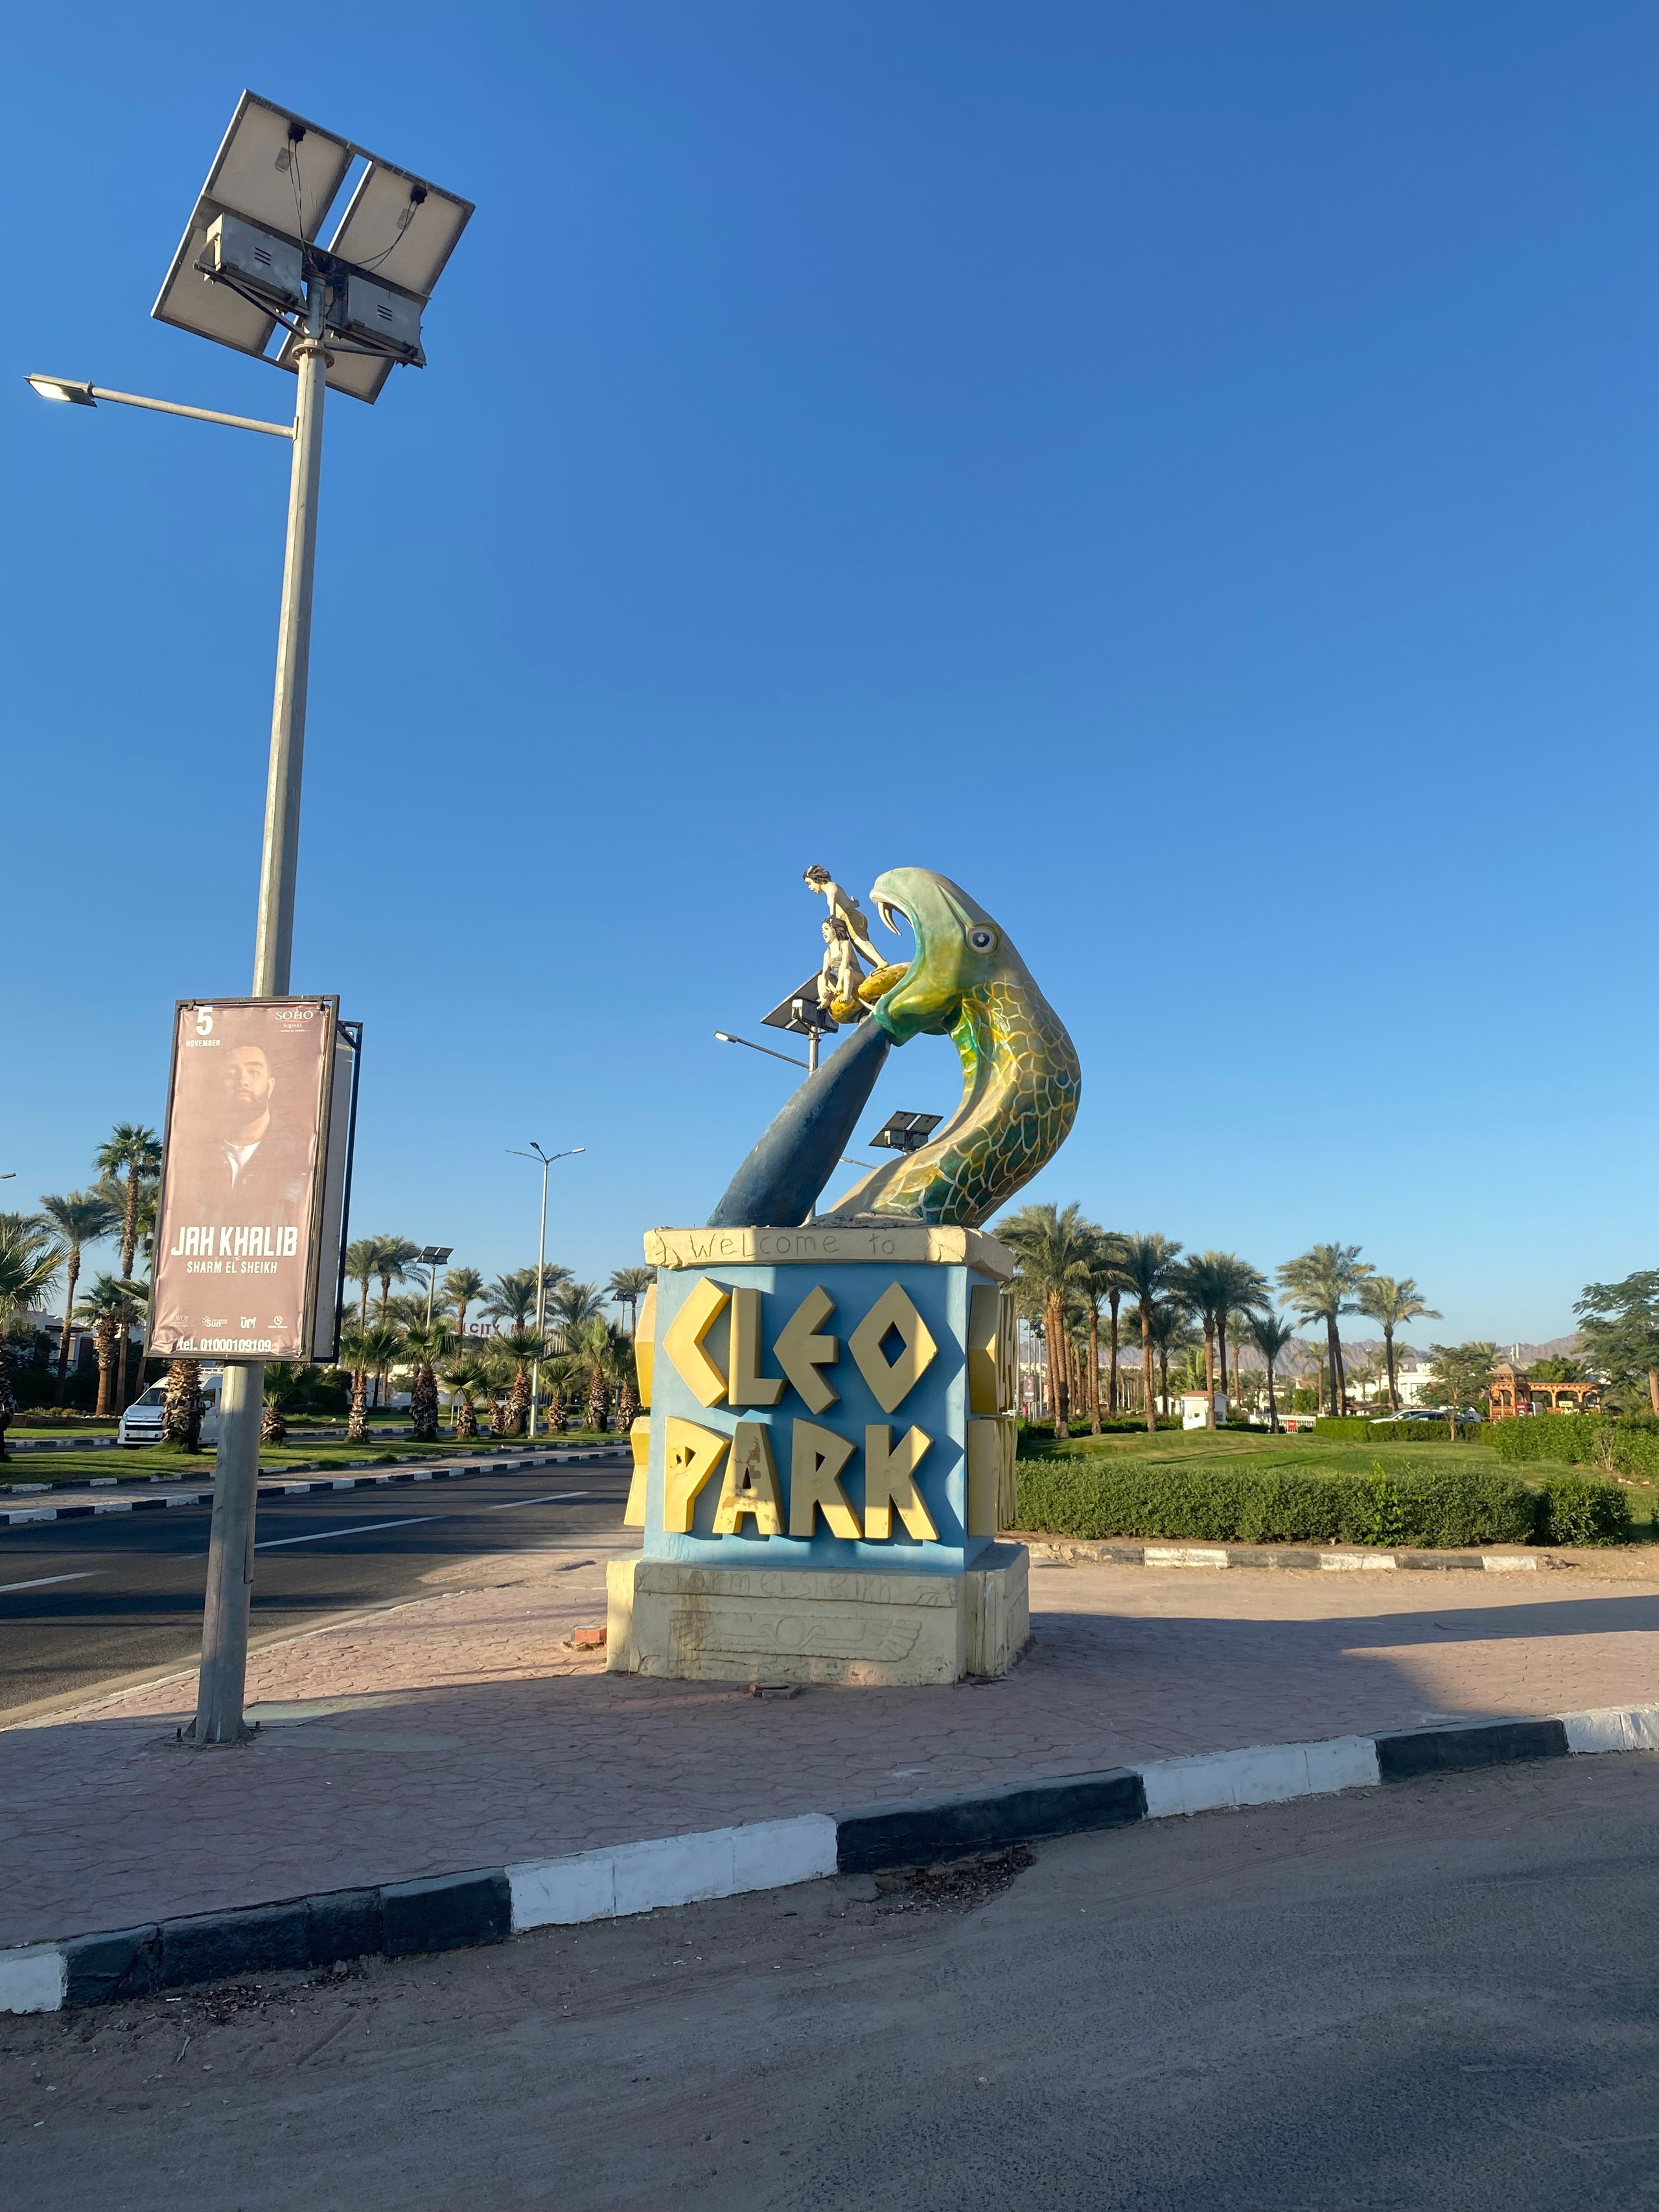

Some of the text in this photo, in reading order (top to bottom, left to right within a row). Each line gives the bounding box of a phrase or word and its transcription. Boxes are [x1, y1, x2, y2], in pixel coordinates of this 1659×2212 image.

[196, 1007, 213, 1036] 5
[275, 1007, 314, 1020] SOHO
[185, 1039, 220, 1047] NOVEMBER
[170, 1226, 298, 1256] JAH KHALIB
[869, 1233, 895, 1255] to
[187, 1261, 277, 1274] SHARM EL SHEIKH
[470, 1323, 500, 1334] CITY
[180, 1336, 272, 1352] tel. 01000109109
[662, 1276, 939, 1415] CLEO
[663, 1415, 940, 1540] PARK
